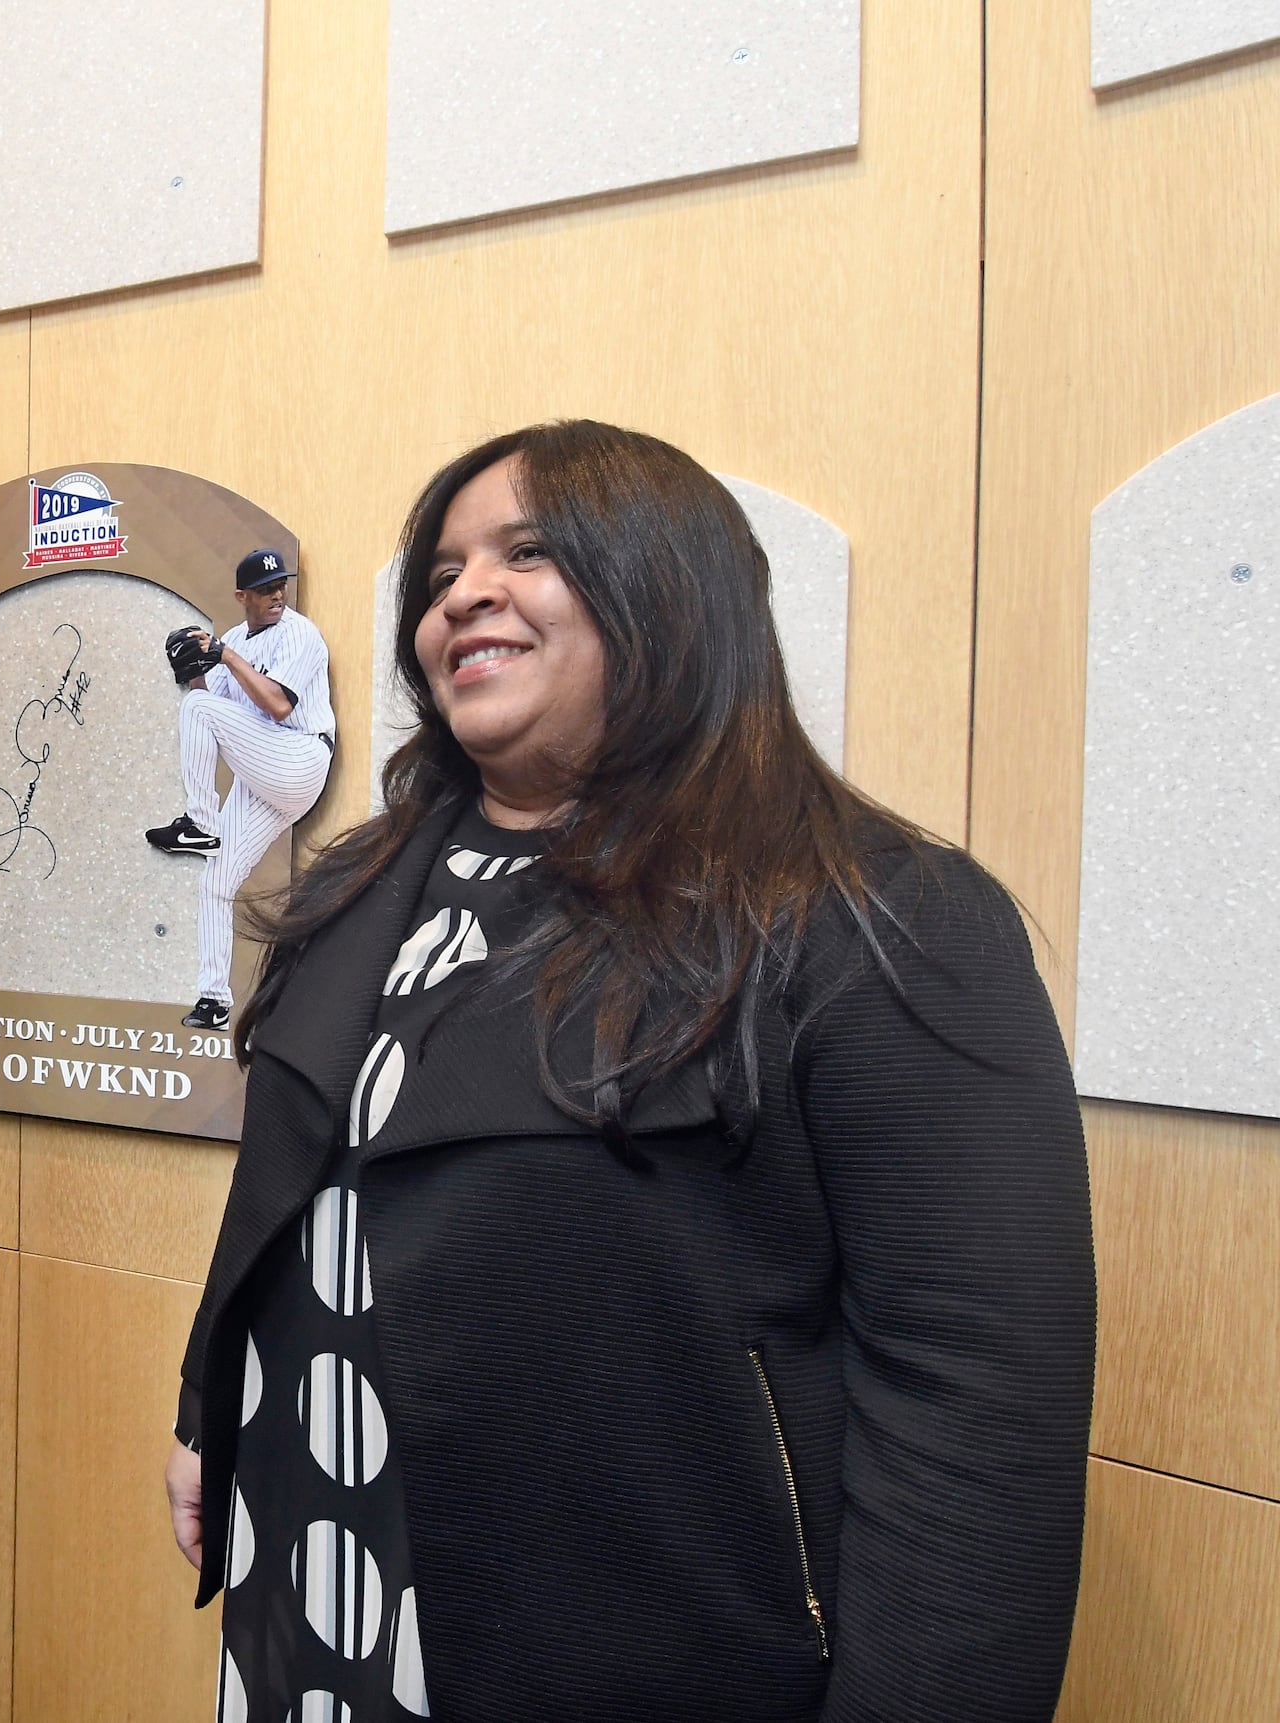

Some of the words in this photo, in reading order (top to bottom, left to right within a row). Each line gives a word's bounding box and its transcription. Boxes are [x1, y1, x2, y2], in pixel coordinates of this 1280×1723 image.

[41, 493, 80, 520] 2019
[35, 525, 116, 546] INDUCTION
[59, 546, 85, 554] HALLADAY
[90, 543, 115, 551] MARTINEZ
[72, 1024, 145, 1051] JULY
[150, 1031, 185, 1060] 21,
[189, 1035, 235, 1060] 201
